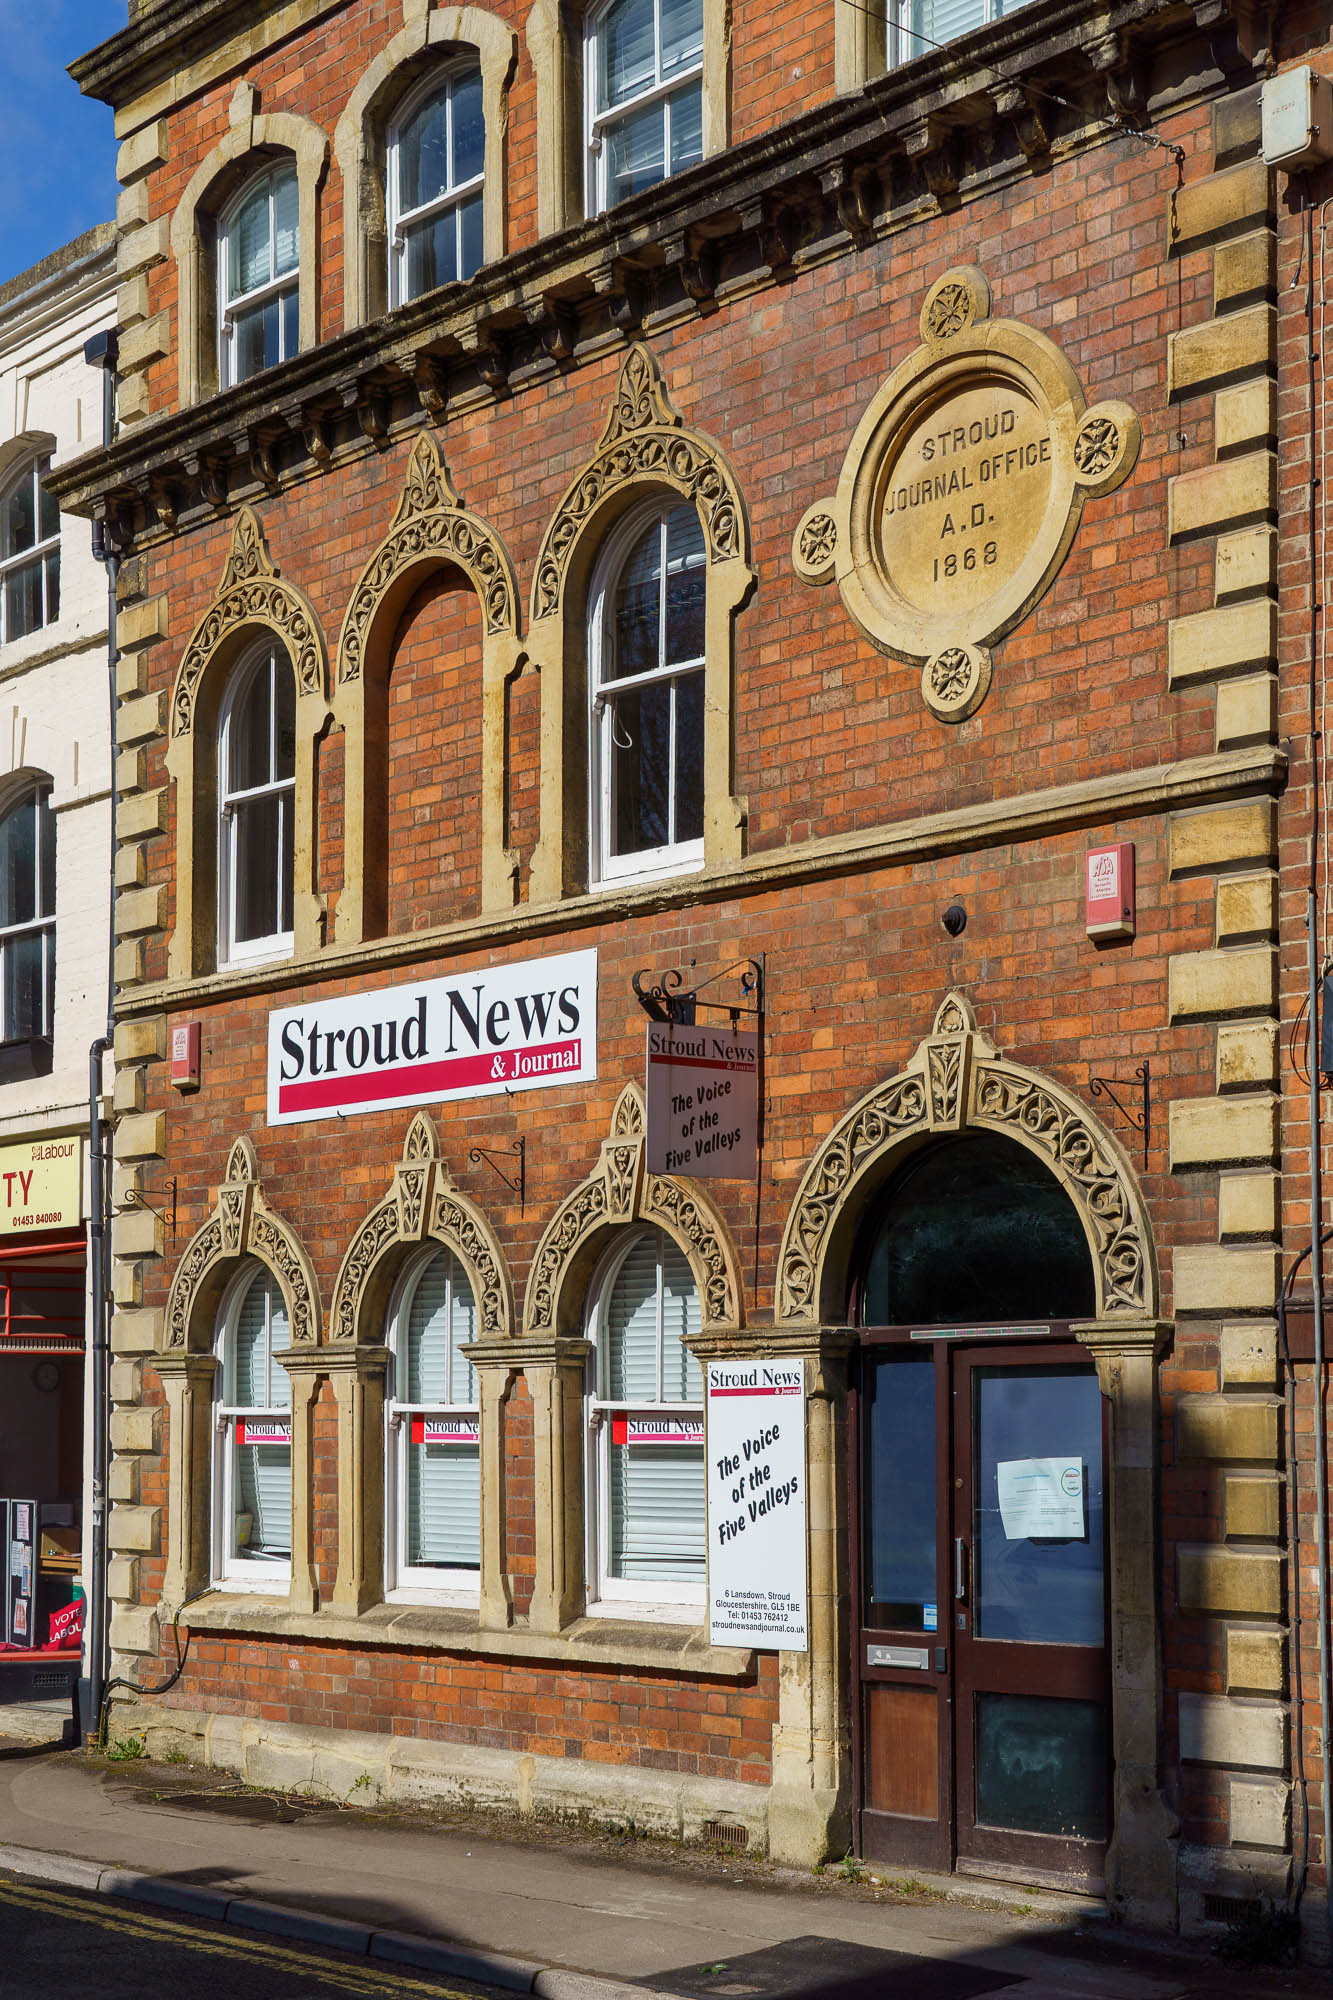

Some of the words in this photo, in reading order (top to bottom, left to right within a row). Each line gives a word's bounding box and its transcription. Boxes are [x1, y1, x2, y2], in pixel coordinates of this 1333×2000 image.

[921, 409, 1015, 462] STROUD
[884, 466, 973, 516] JOURNAL
[979, 437, 1052, 482] OFFICE
[940, 503, 995, 539] A.D.
[933, 541, 998, 582] 1868
[280, 997, 429, 1082] Stroud
[444, 984, 581, 1053] News
[650, 1032, 706, 1057] Stroud
[712, 1039, 755, 1062] News
[490, 1055, 506, 1079] &
[511, 1043, 580, 1079] Journal
[672, 1093, 693, 1115] The
[697, 1080, 731, 1105] Voice
[682, 1116, 695, 1138] of
[699, 1110, 719, 1131] the
[40, 1143, 75, 1160] Labour
[665, 1149, 691, 1171] Five
[695, 1127, 741, 1158] Valleys
[2, 1169, 34, 1208] TY
[13, 1214, 34, 1227] 01453
[36, 1211, 62, 1224] 840080
[710, 1369, 758, 1388] Stroud
[762, 1368, 801, 1386] News
[246, 1420, 276, 1435] Stroud
[279, 1421, 291, 1435] Ne
[425, 1418, 461, 1433] Stroud
[464, 1418, 479, 1434] Ne
[628, 1418, 670, 1433] Stroud
[717, 1454, 740, 1480] The
[742, 1424, 780, 1461] Voice
[732, 1477, 745, 1503] of
[749, 1465, 771, 1491] the
[718, 1515, 746, 1545] Five
[748, 1476, 799, 1523] Valleys
[715, 1599, 770, 1611] Gloucestershire,
[771, 1602, 785, 1611] GL5
[786, 1603, 801, 1612] 1BE
[724, 1589, 730, 1598] 6
[731, 1590, 767, 1600] Lansdown,
[768, 1591, 791, 1601] Stroud
[55, 1607, 82, 1627] VOTE
[712, 1620, 805, 1634] stroudnewsandjournal.co.uk
[728, 1610, 740, 1619] Tel:
[741, 1611, 762, 1621] 01453
[764, 1612, 789, 1622] 762412
